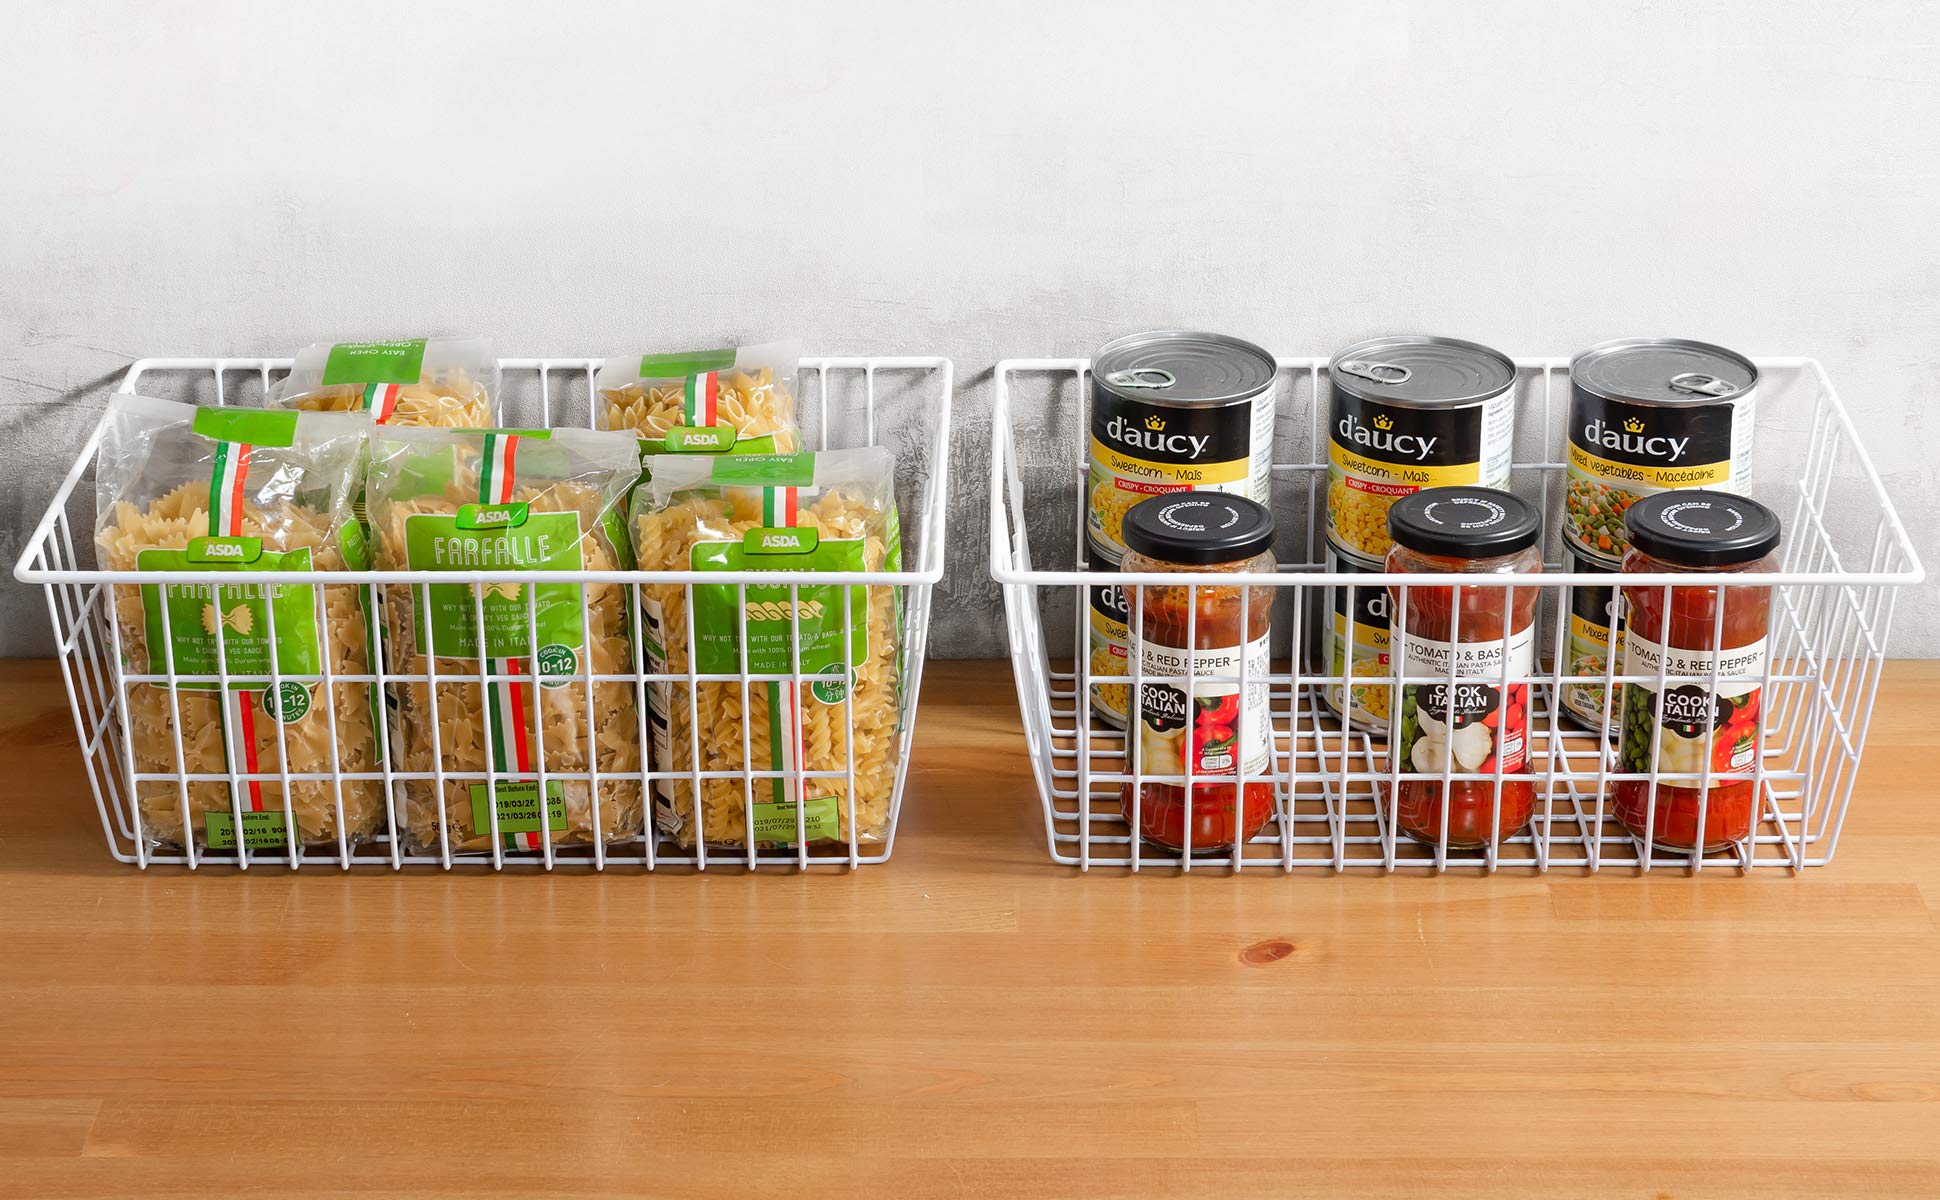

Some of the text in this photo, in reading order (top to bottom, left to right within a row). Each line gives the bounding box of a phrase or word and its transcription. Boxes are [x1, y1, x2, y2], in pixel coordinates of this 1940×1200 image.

[683, 433, 719, 446] ASDA
[1110, 455, 1163, 479] Sweetcorn
[1342, 453, 1390, 479] Sweetcorn
[1590, 459, 1644, 482] vegetables
[1117, 480, 1188, 495] CRISPY CROQUANT
[1348, 480, 1415, 496] CRISPY CROQUANT
[475, 510, 512, 524] ASDA
[761, 535, 800, 548] ASDA
[205, 544, 244, 557] ASDA
[433, 534, 552, 566] FARFALLE
[493, 638, 505, 648] IN
[719, 635, 732, 643] NOT
[751, 635, 768, 643] WITH
[768, 647, 786, 655] 100%
[1464, 650, 1474, 661] &
[541, 656, 573, 674] 0-12
[753, 661, 776, 669] MADE
[778, 661, 788, 669] IN
[1146, 650, 1154, 661] &
[1156, 653, 1180, 667] RED
[1408, 653, 1441, 667] AUTHENTIC
[1470, 661, 1492, 669] PASTA
[1676, 659, 1686, 670] &
[1690, 660, 1713, 671] RED
[1720, 652, 1758, 670] PEPPER
[266, 693, 306, 709] 1-12
[1141, 684, 1180, 704] COOK
[1667, 693, 1711, 707] COOK
[1141, 694, 1186, 716] TALIAN
[1664, 702, 1720, 718] TALIAN
[496, 810, 537, 821] 021/03/26
[753, 815, 822, 826] 019/07/29 210
[431, 821, 451, 834] 50g
[754, 823, 796, 832] 021/07/29
